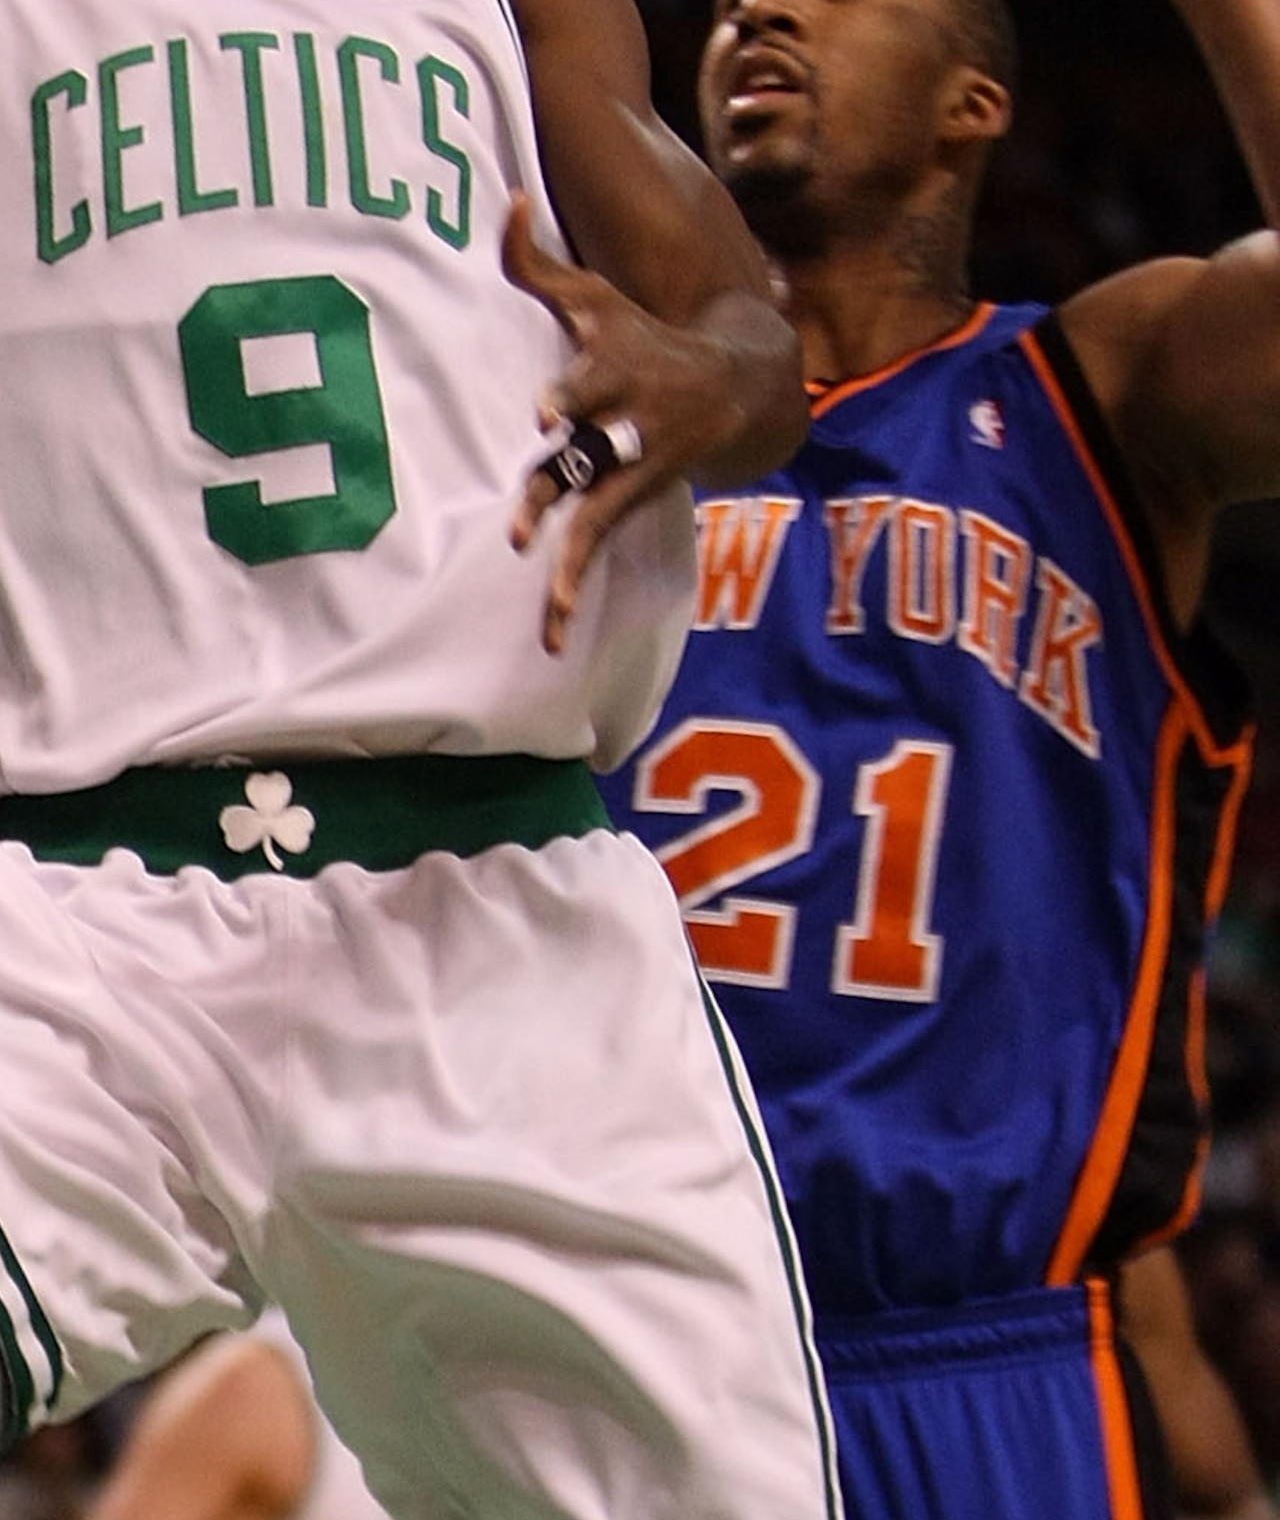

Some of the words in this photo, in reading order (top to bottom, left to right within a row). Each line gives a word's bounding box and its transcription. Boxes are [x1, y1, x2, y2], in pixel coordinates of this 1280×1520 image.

[31, 32, 471, 266] CELTICS
[177, 274, 397, 567] 9
[824, 494, 1104, 759] YORK
[632, 717, 955, 1004] 21
